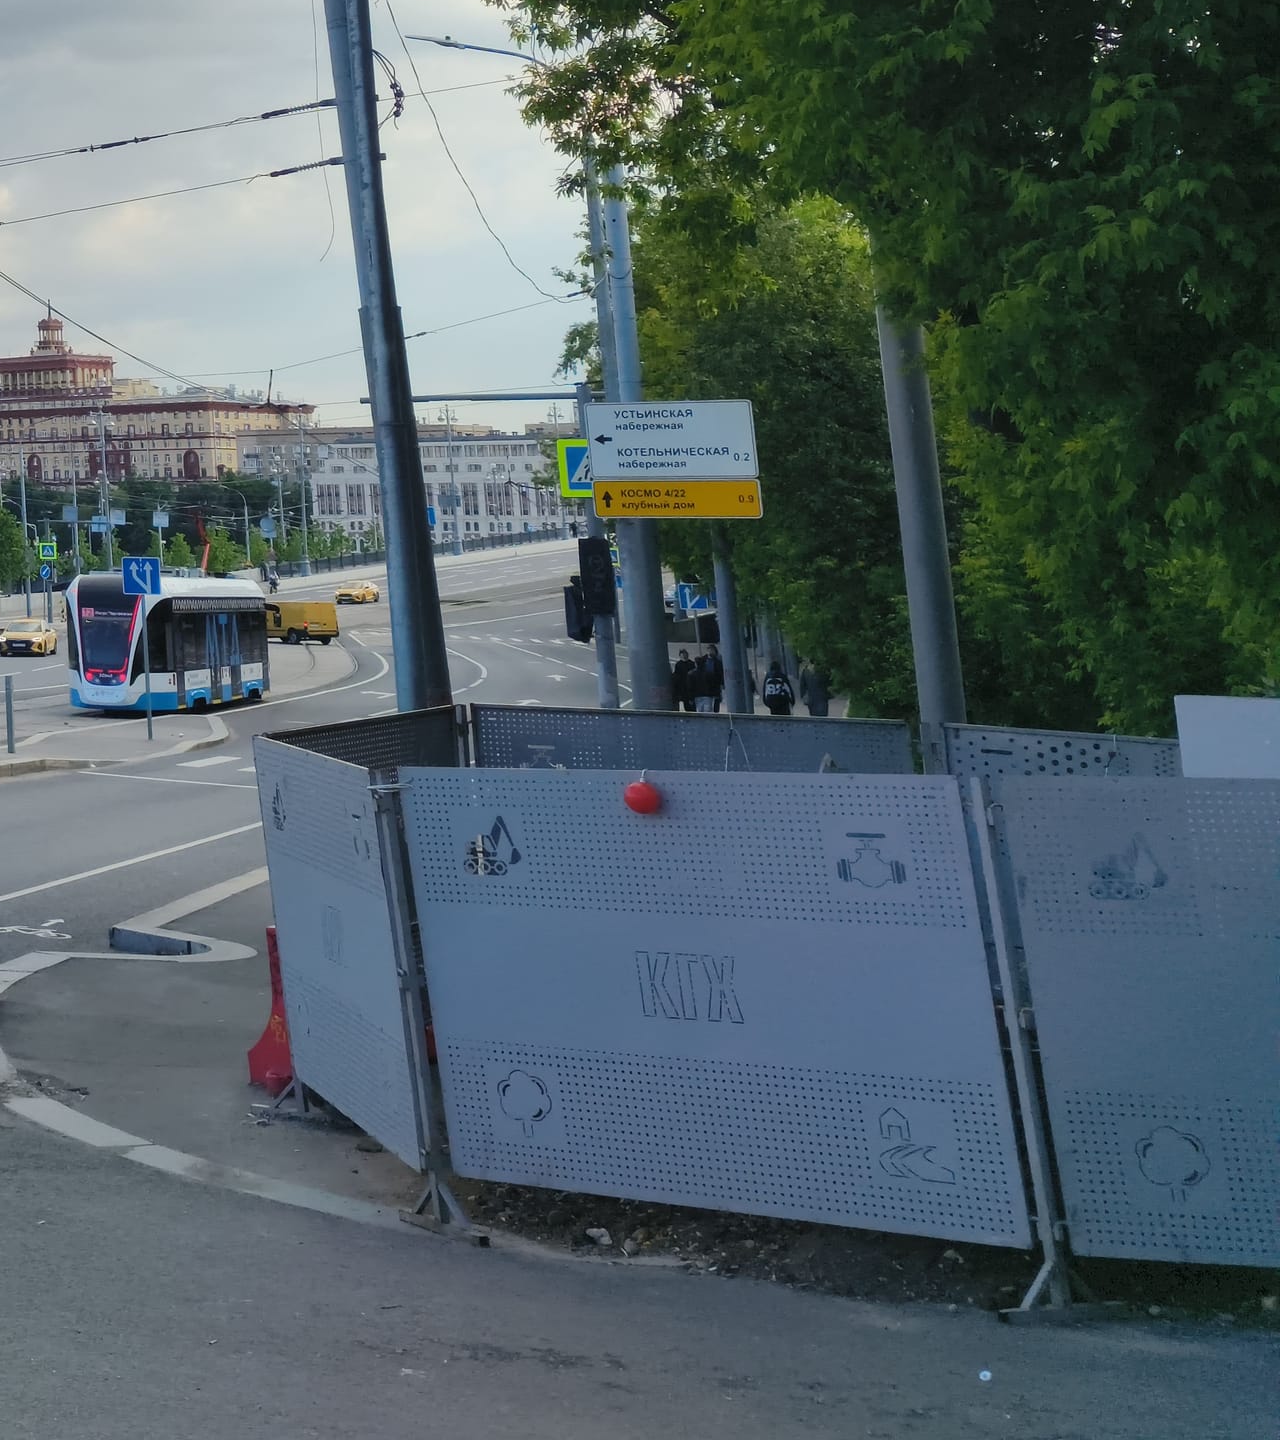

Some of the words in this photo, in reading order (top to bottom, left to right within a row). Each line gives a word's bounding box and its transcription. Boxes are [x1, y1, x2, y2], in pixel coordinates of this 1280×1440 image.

[614, 409, 693, 419] УСТЬИНСКАЯ
[615, 422, 684, 432] набережная
[617, 447, 729, 457] КОТЕЛЬНИЧЕСКАЯ
[618, 460, 687, 470] набережная
[620, 488, 662, 498] КОСМО
[664, 488, 686, 498] 4/22
[621, 501, 670, 511] клубный
[673, 501, 695, 510] дом
[635, 950, 744, 1024] КГХ
